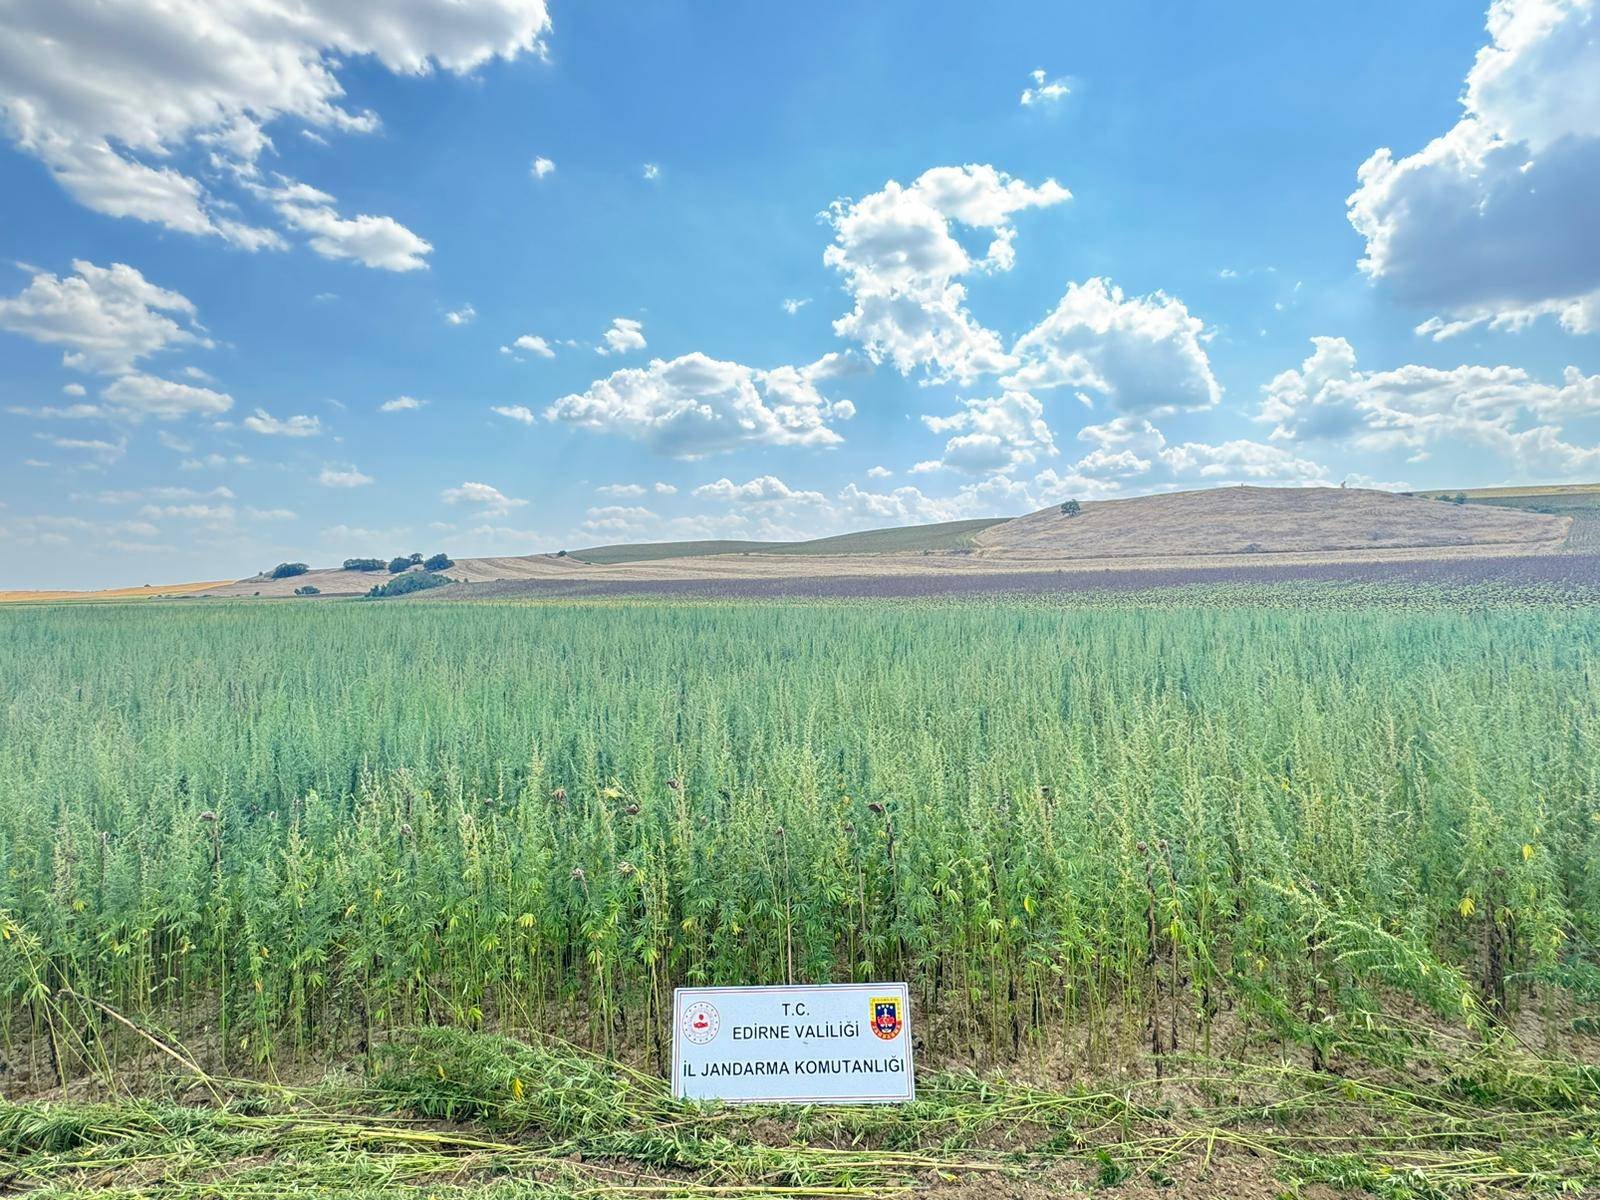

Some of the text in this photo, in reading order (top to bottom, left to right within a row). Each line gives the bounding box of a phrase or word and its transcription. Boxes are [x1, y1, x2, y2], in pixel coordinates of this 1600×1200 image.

[781, 1002, 810, 1016] T.C.
[733, 1022, 790, 1040] EDİRNE
[794, 1020, 859, 1039] VALİLİĞİ
[683, 1055, 905, 1077] İL JANDARMA KOMUTANLIĞI
